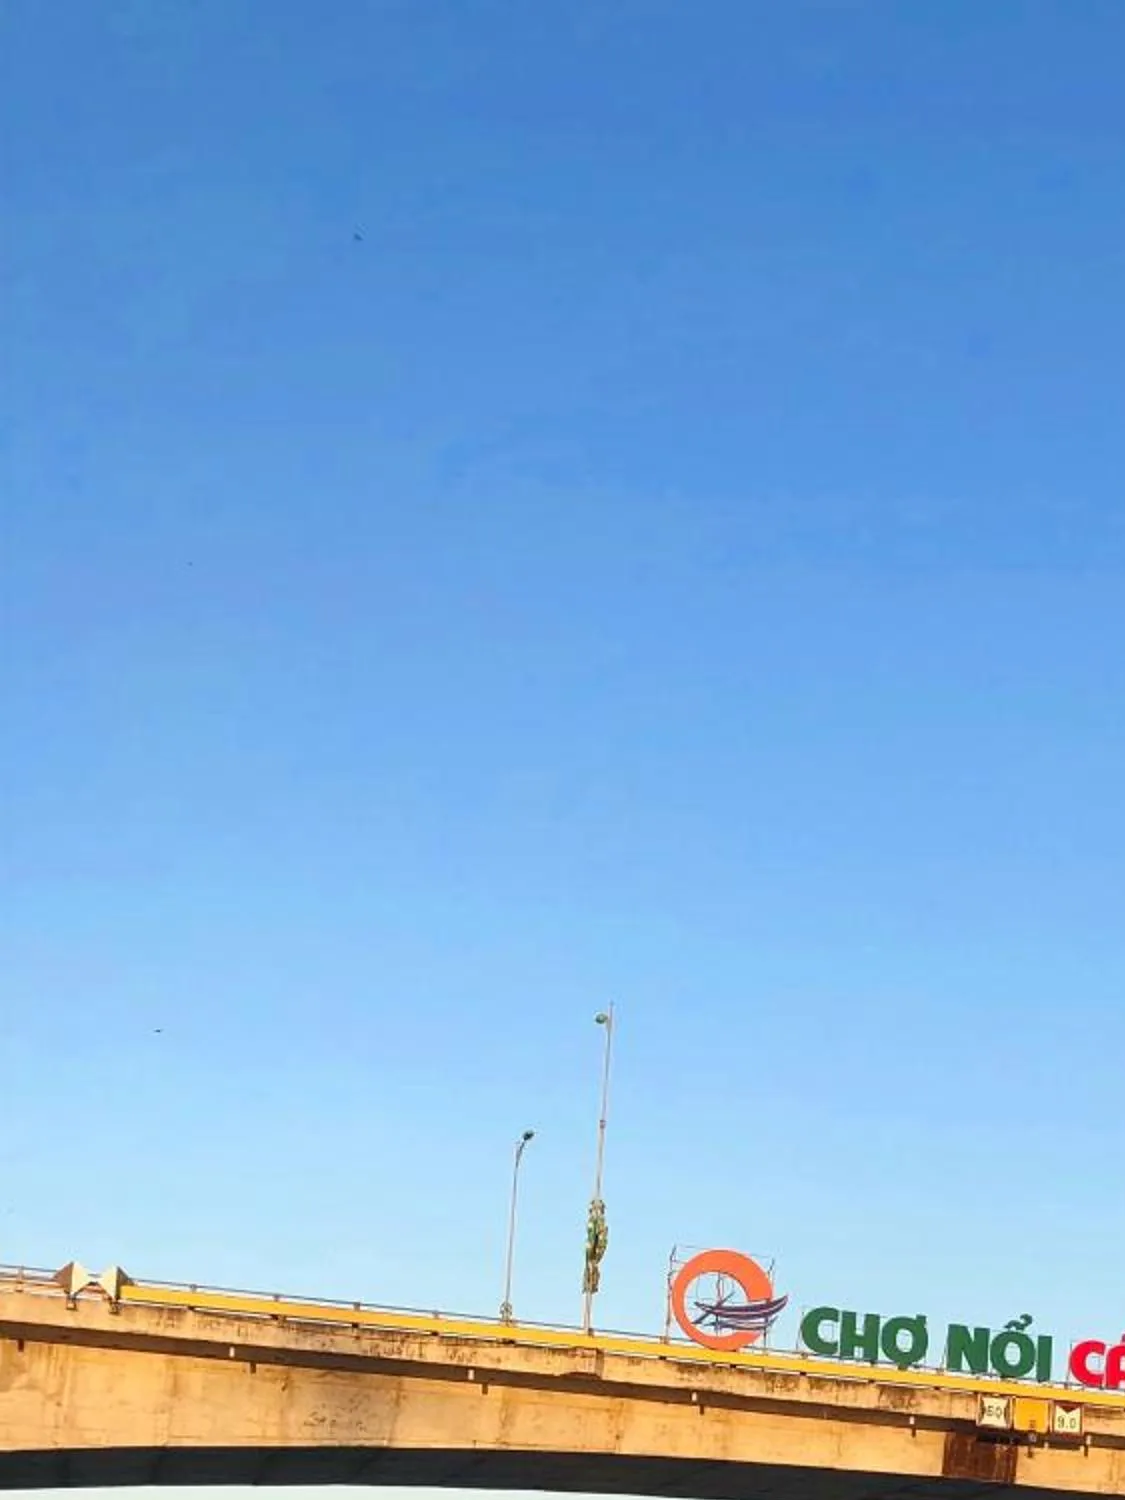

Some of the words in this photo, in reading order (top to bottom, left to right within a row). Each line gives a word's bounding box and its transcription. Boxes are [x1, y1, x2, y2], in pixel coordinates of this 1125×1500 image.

[800, 1306, 929, 1370] CHỢ
[947, 1313, 1053, 1382] NỔI
[1057, 1415, 1077, 1430] 9.0
